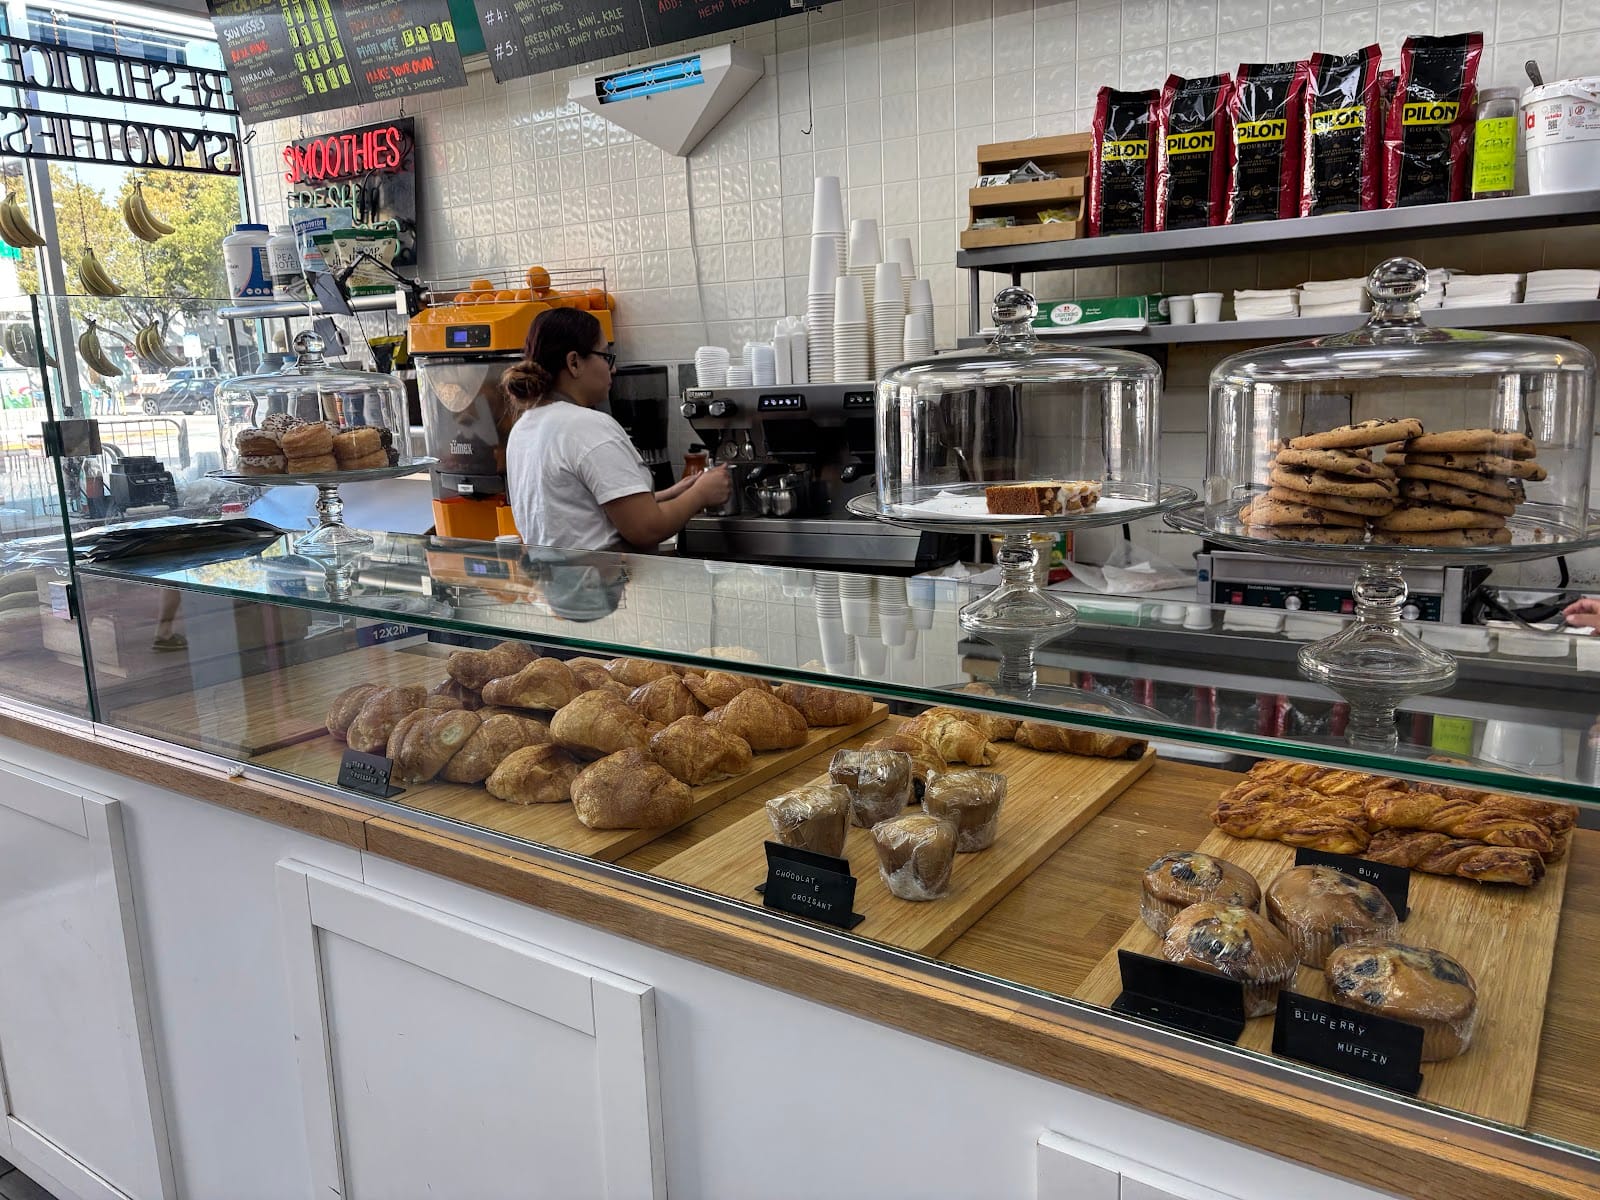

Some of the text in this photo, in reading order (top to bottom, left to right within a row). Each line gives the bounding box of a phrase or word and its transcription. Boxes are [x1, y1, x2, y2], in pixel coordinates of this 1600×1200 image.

[541, 2, 564, 16] PEARS
[698, 2, 725, 19] HEMP
[223, 26, 241, 42] SUN
[241, 16, 266, 36] KISSES
[524, 32, 549, 46] GREEN
[601, 7, 624, 23] KALE
[527, 22, 624, 60] SPINACH HONEY MELON
[240, 67, 276, 86] MARACANA
[365, 67, 391, 84] MAKE
[391, 60, 411, 77] YOUR
[1403, 106, 1457, 121] PILON
[1238, 122, 1285, 138] PILON
[1167, 135, 1213, 151] PILON
[1241, 142, 1277, 150] GOURMET
[282, 126, 401, 184] SMOOTHIES
[277, 253, 293, 261] PEA
[372, 625, 409, 640] 12X2M
[775, 869, 815, 884] CHOCOLAT
[1359, 867, 1380, 880] BUN
[1294, 1010, 1366, 1036] BLUEERRY
[1337, 1042, 1388, 1066] MUFFIN
